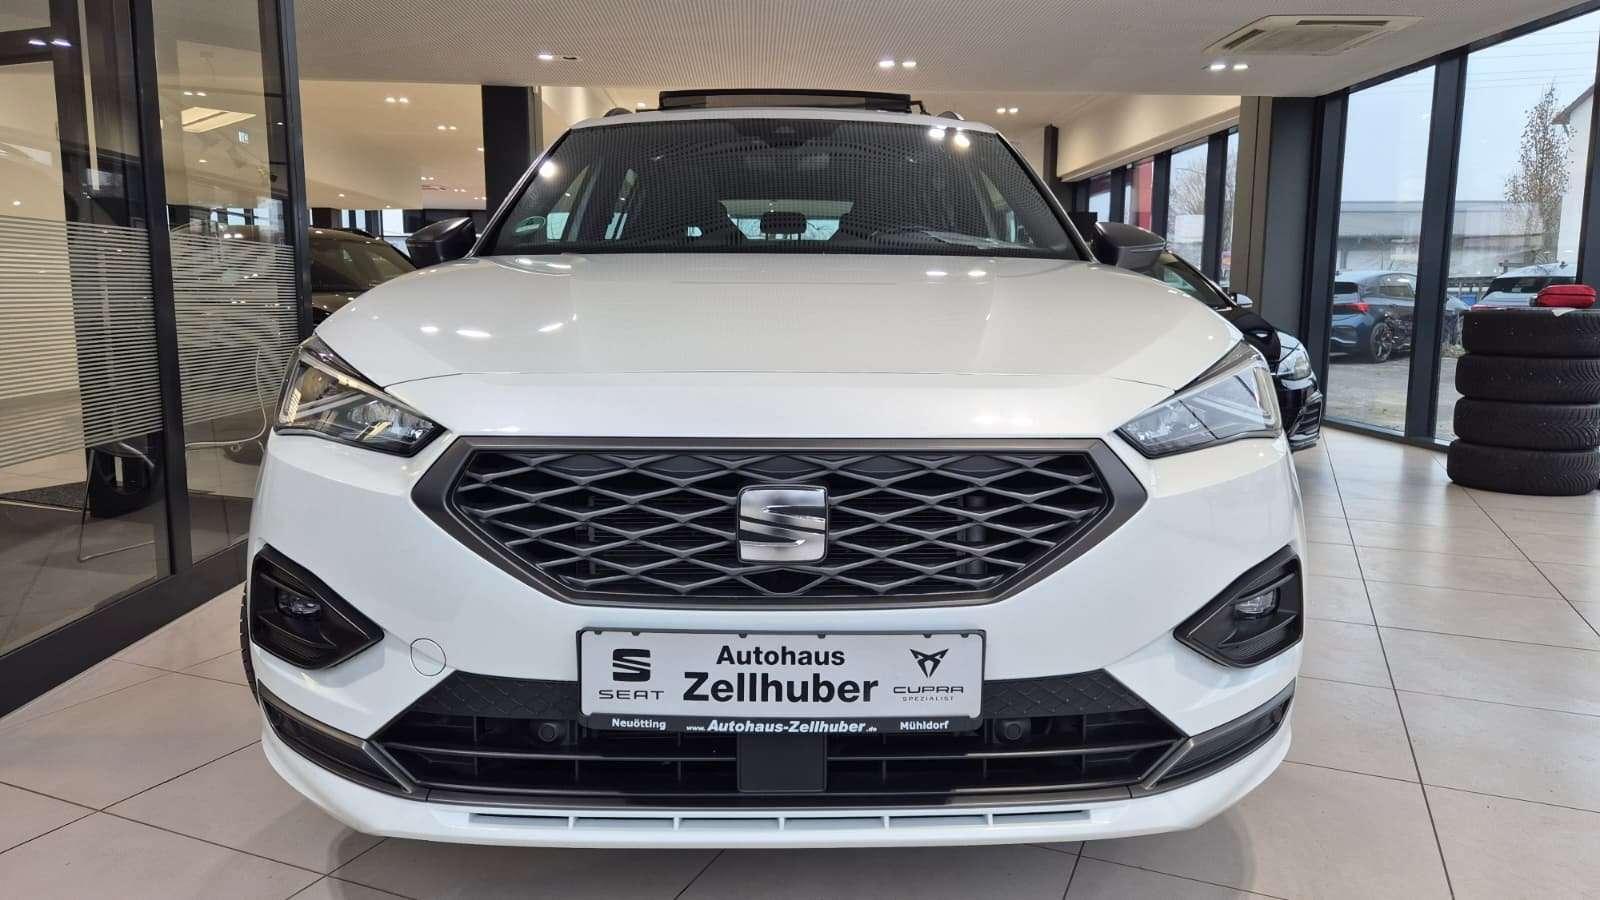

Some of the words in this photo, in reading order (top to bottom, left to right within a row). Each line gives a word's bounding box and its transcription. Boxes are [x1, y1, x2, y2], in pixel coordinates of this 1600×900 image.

[716, 645, 845, 666] Autohaus
[683, 671, 879, 703] Zellhuber
[893, 686, 964, 694] CUPRA
[598, 689, 665, 700] SEAT
[611, 717, 667, 731] Neuötting
[686, 719, 878, 734] www.Autohaus-Zellhuber.de
[899, 719, 950, 731] Mühldorf
